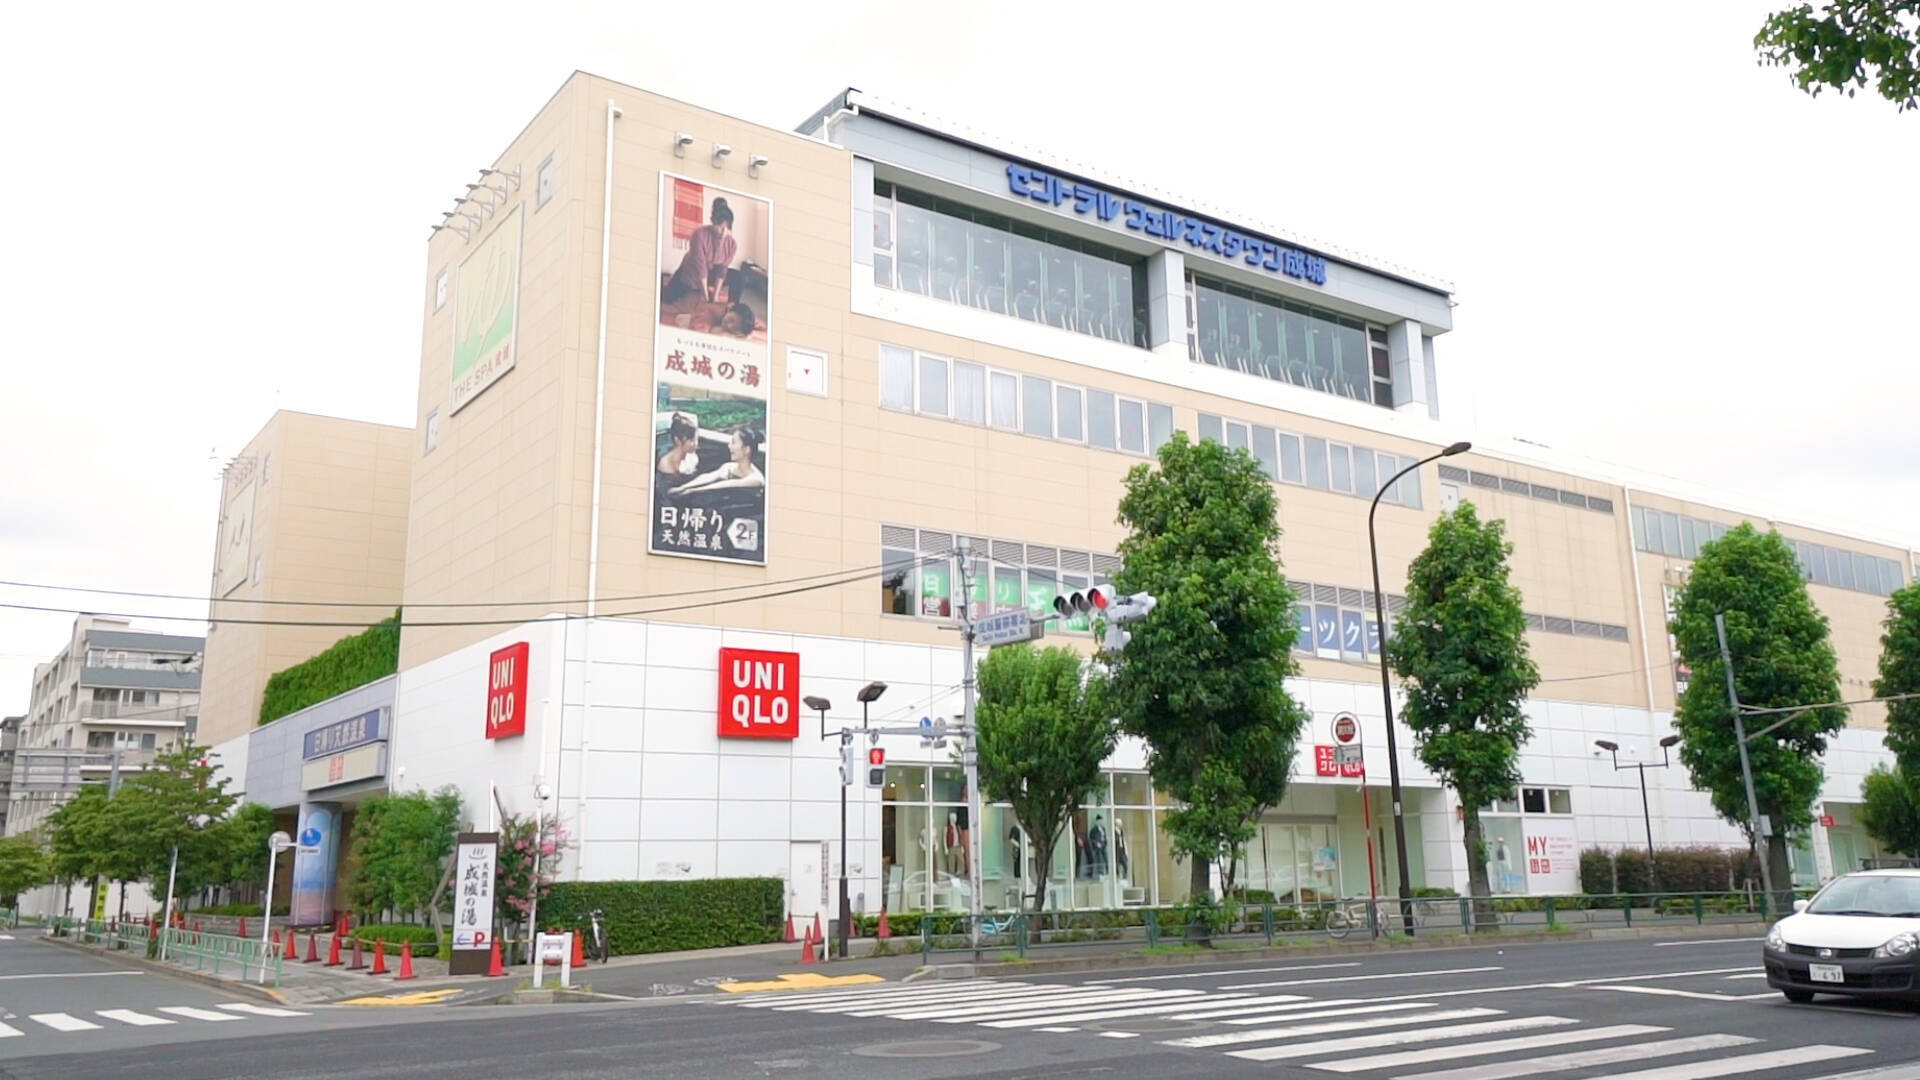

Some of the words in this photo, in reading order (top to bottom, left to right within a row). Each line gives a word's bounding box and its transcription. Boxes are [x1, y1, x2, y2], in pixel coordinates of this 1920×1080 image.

[665, 349, 761, 388] 成城の湯
[661, 506, 723, 533] 日帰り
[736, 522, 754, 541] 2F
[662, 529, 723, 551] 天然温泉
[493, 656, 515, 690] UNI
[733, 659, 784, 691] UNI
[491, 692, 514, 730] QLO
[732, 694, 789, 728] QLO
[1527, 835, 1546, 856] MY
[473, 931, 485, 948] P
